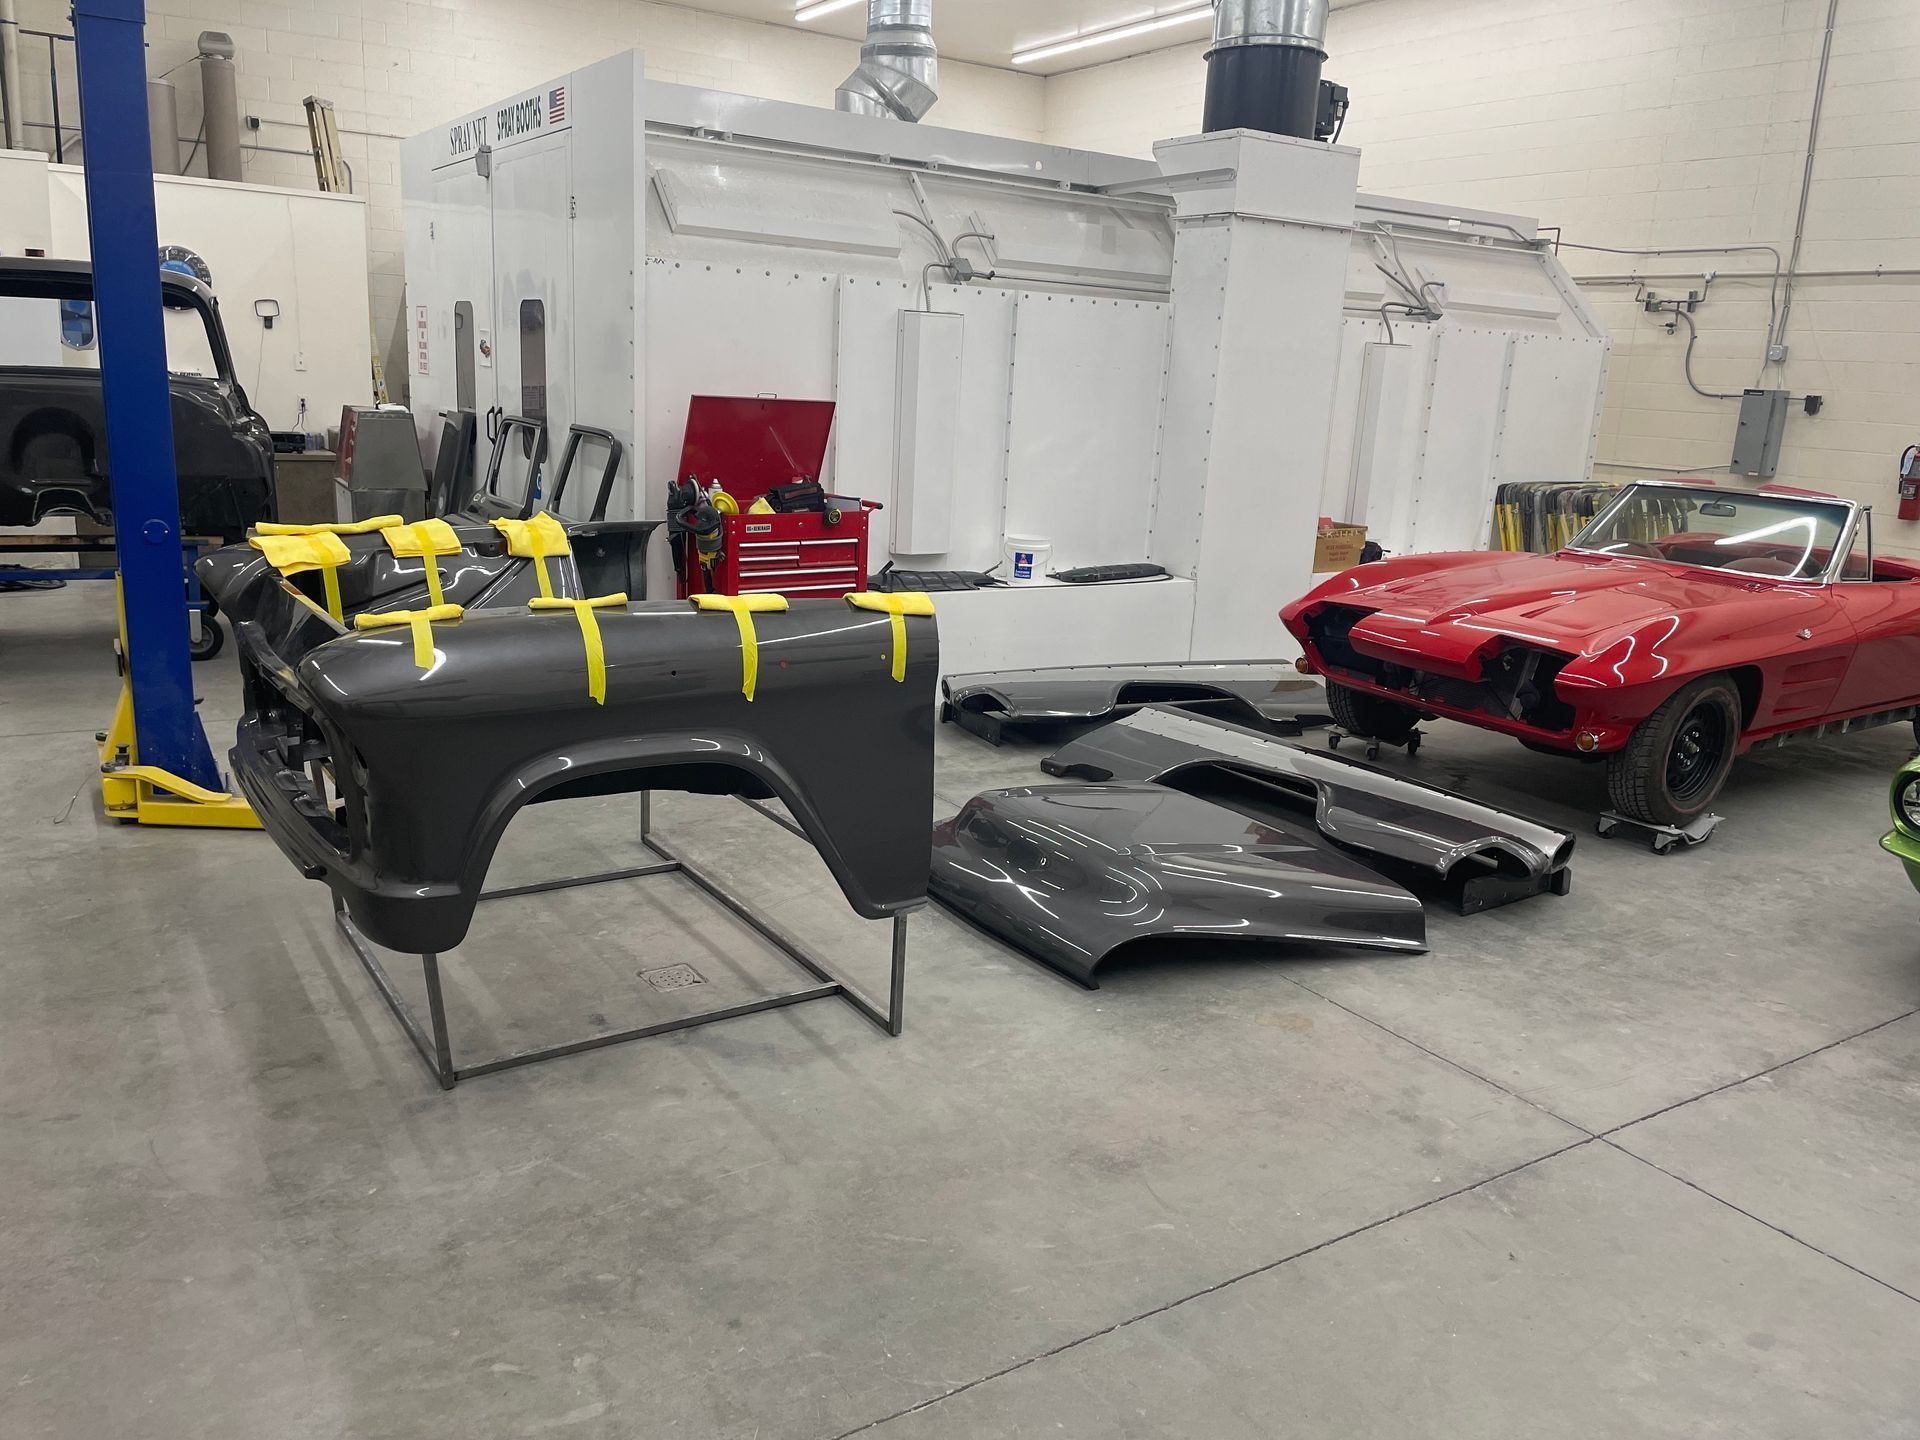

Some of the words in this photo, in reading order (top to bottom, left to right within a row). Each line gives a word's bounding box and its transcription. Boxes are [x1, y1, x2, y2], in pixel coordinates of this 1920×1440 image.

[497, 105, 515, 141] SPRAY
[516, 95, 541, 134] BOOTHS
[450, 121, 471, 156] SPRAY
